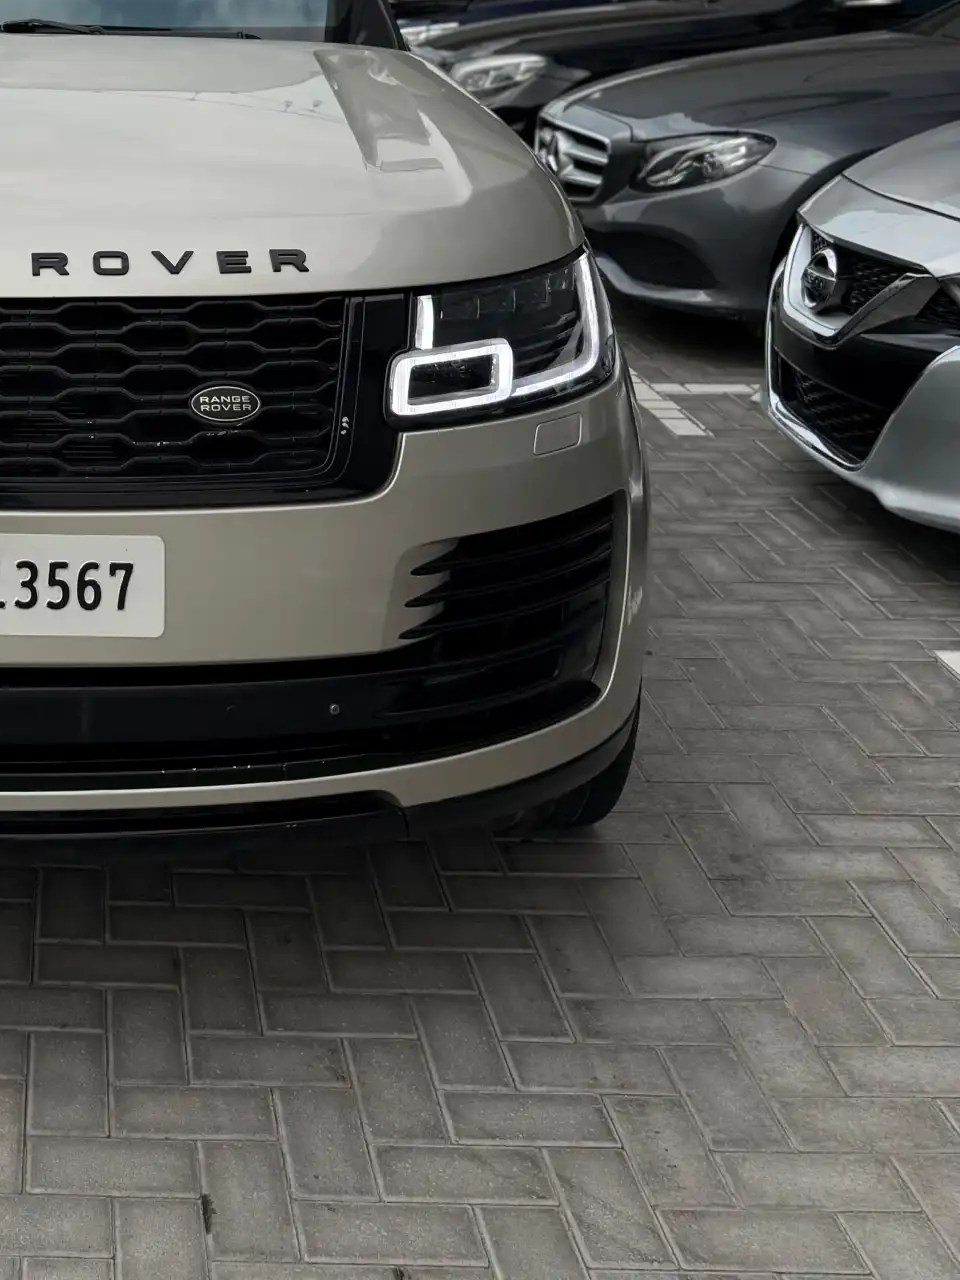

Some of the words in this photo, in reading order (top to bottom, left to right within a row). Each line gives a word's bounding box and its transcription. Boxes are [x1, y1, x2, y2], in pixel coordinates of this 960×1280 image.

[31, 248, 310, 276] ROVER
[199, 395, 251, 404] RANGE
[200, 403, 252, 412] ROVER
